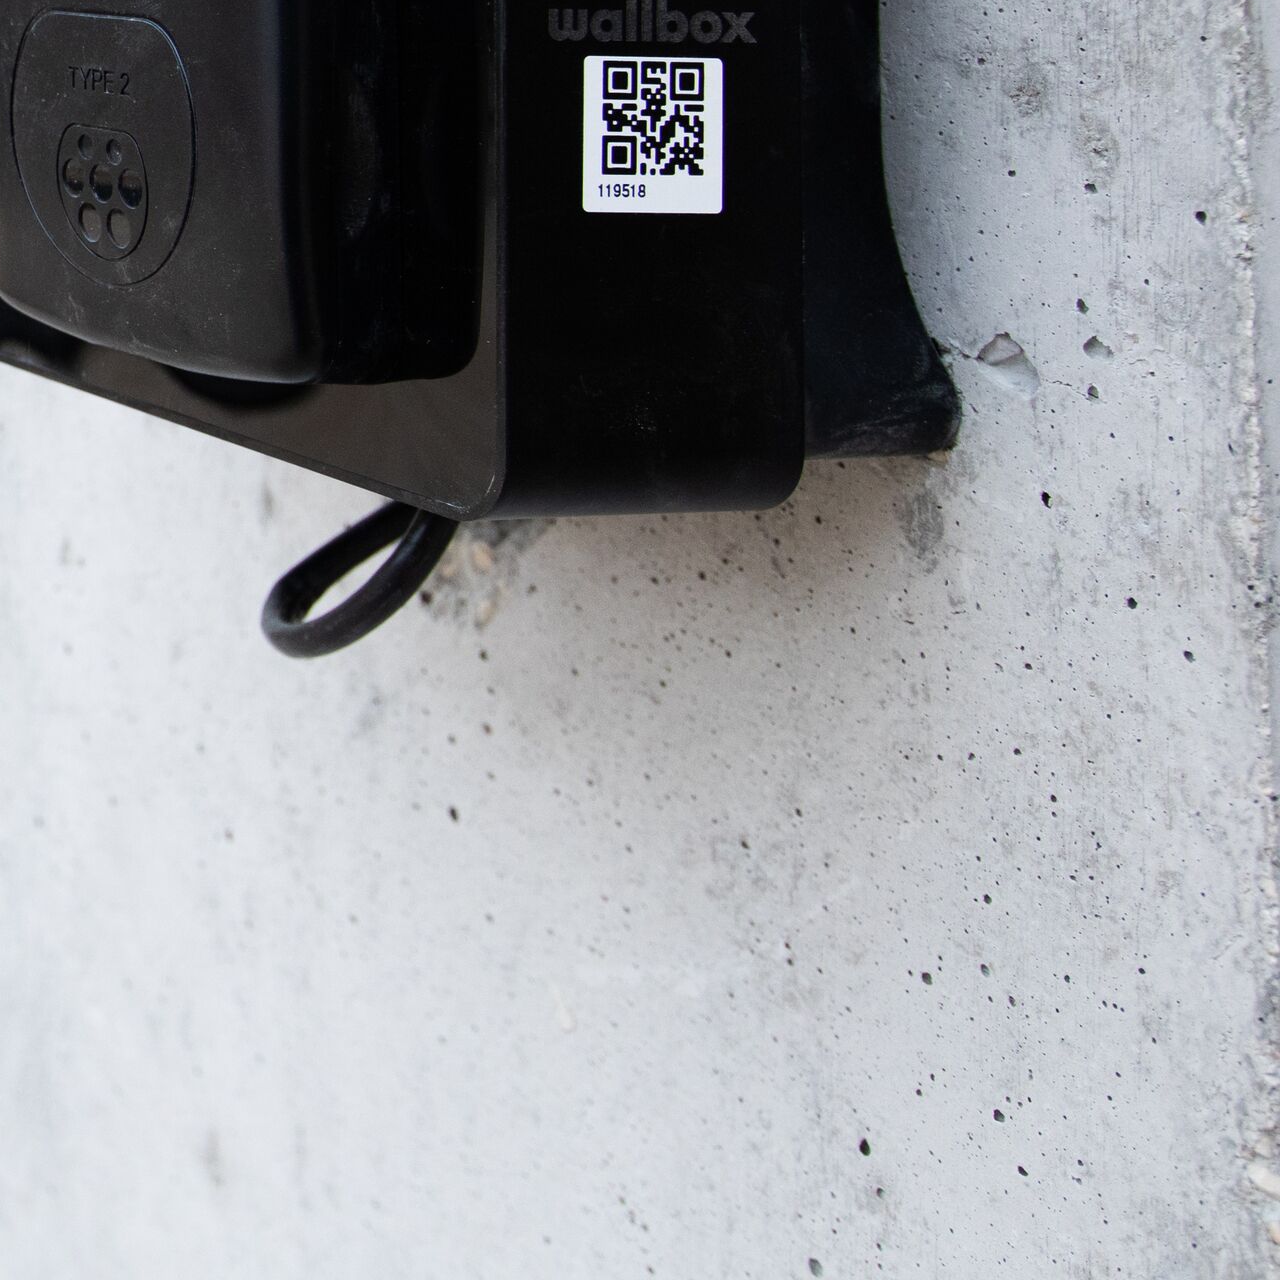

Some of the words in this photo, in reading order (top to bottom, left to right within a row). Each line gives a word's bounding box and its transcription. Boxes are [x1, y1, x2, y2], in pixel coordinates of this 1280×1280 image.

[68, 66, 115, 94] TYPE
[120, 72, 130, 96] 2
[597, 183, 647, 198] 119518
